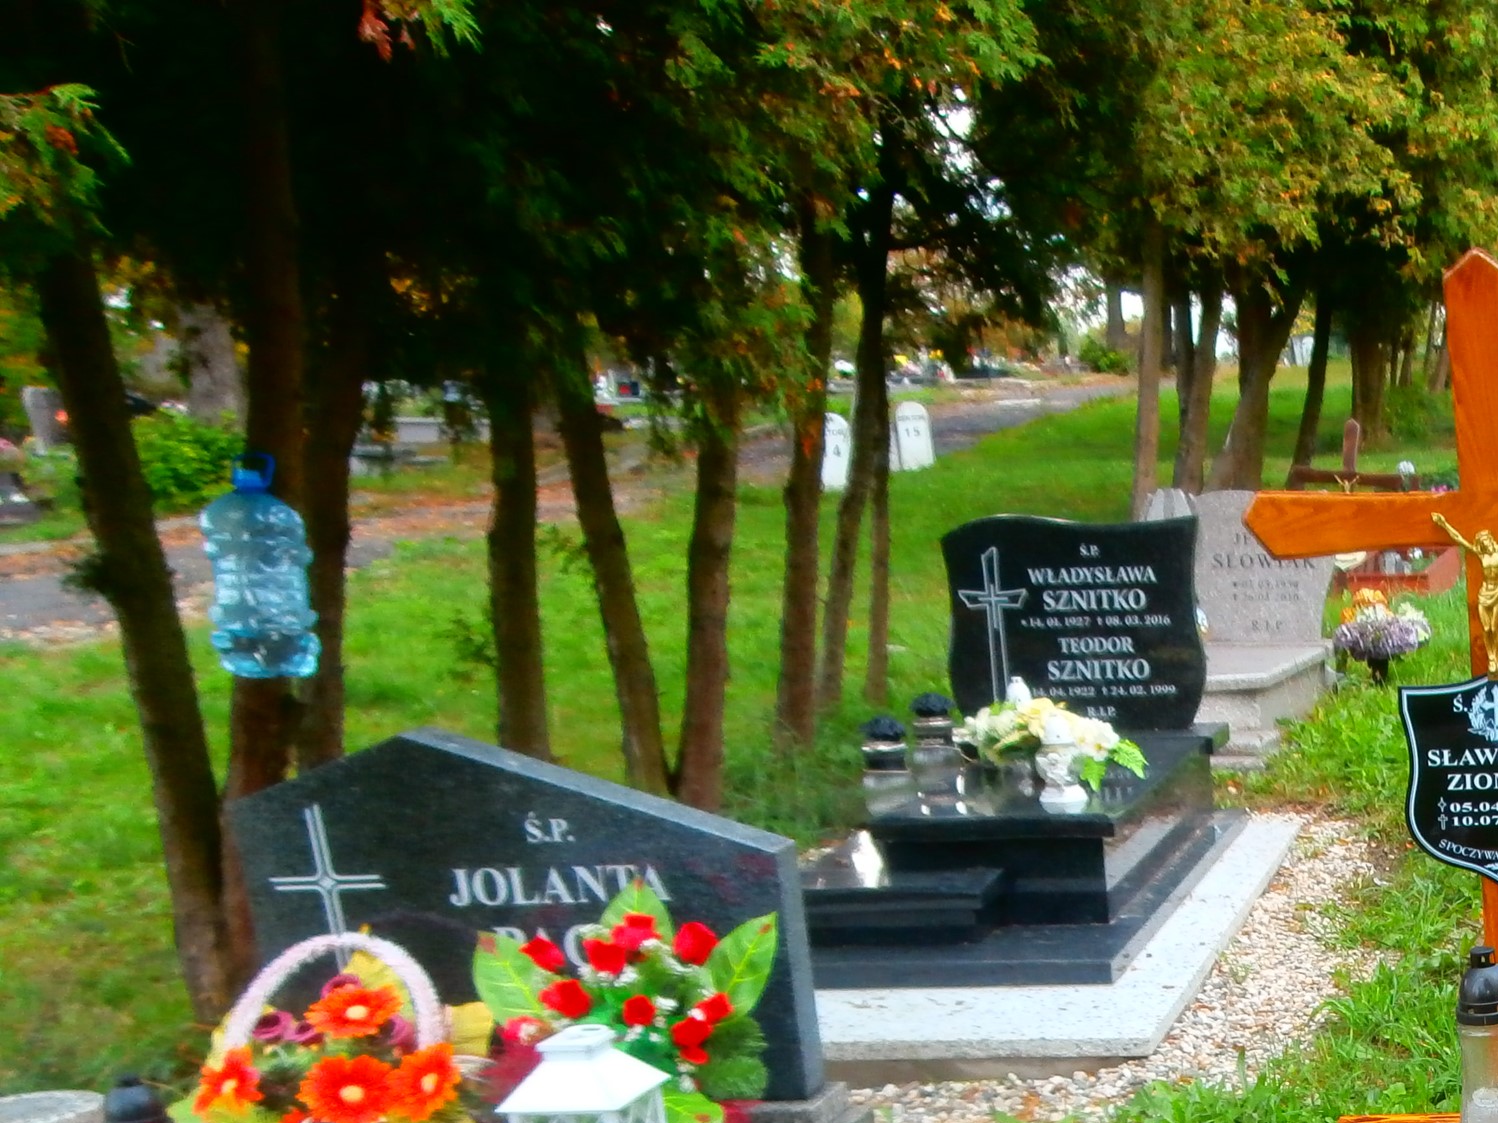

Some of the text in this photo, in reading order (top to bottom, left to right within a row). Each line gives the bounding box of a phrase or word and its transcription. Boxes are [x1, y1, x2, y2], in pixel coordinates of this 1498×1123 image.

[1027, 565, 1158, 586] WŁADYSŁAWA
[1042, 588, 1149, 612] SZNITKO
[1144, 614, 1171, 626] 2016
[1057, 636, 1135, 654] TEODOR
[1047, 658, 1151, 680] SZNITKO
[524, 810, 577, 843] Ś.P.
[449, 864, 673, 907] JOLANTA
